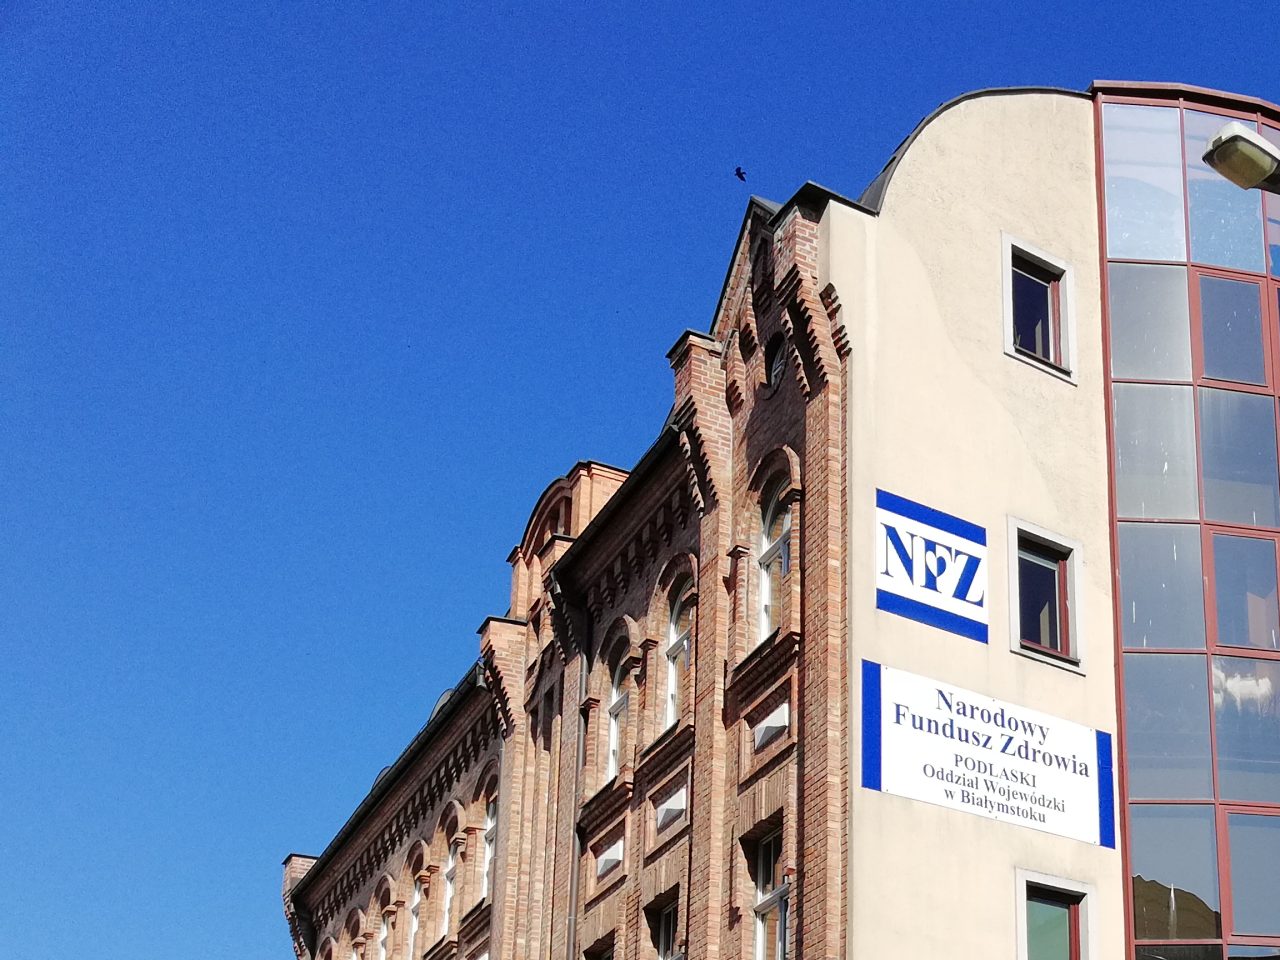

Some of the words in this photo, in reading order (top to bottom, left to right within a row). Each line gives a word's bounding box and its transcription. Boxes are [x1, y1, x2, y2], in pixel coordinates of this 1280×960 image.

[880, 521, 985, 608] NFZ
[892, 702, 993, 751] Fundusz
[999, 733, 1090, 778] Zdrowia
[935, 688, 1050, 745] Narodowy
[923, 763, 979, 790] Oddział
[983, 778, 1066, 813] Wojewódzki
[954, 753, 1037, 788] PODLASKI
[944, 788, 956, 800] w
[960, 789, 1047, 824] Białymstoku
